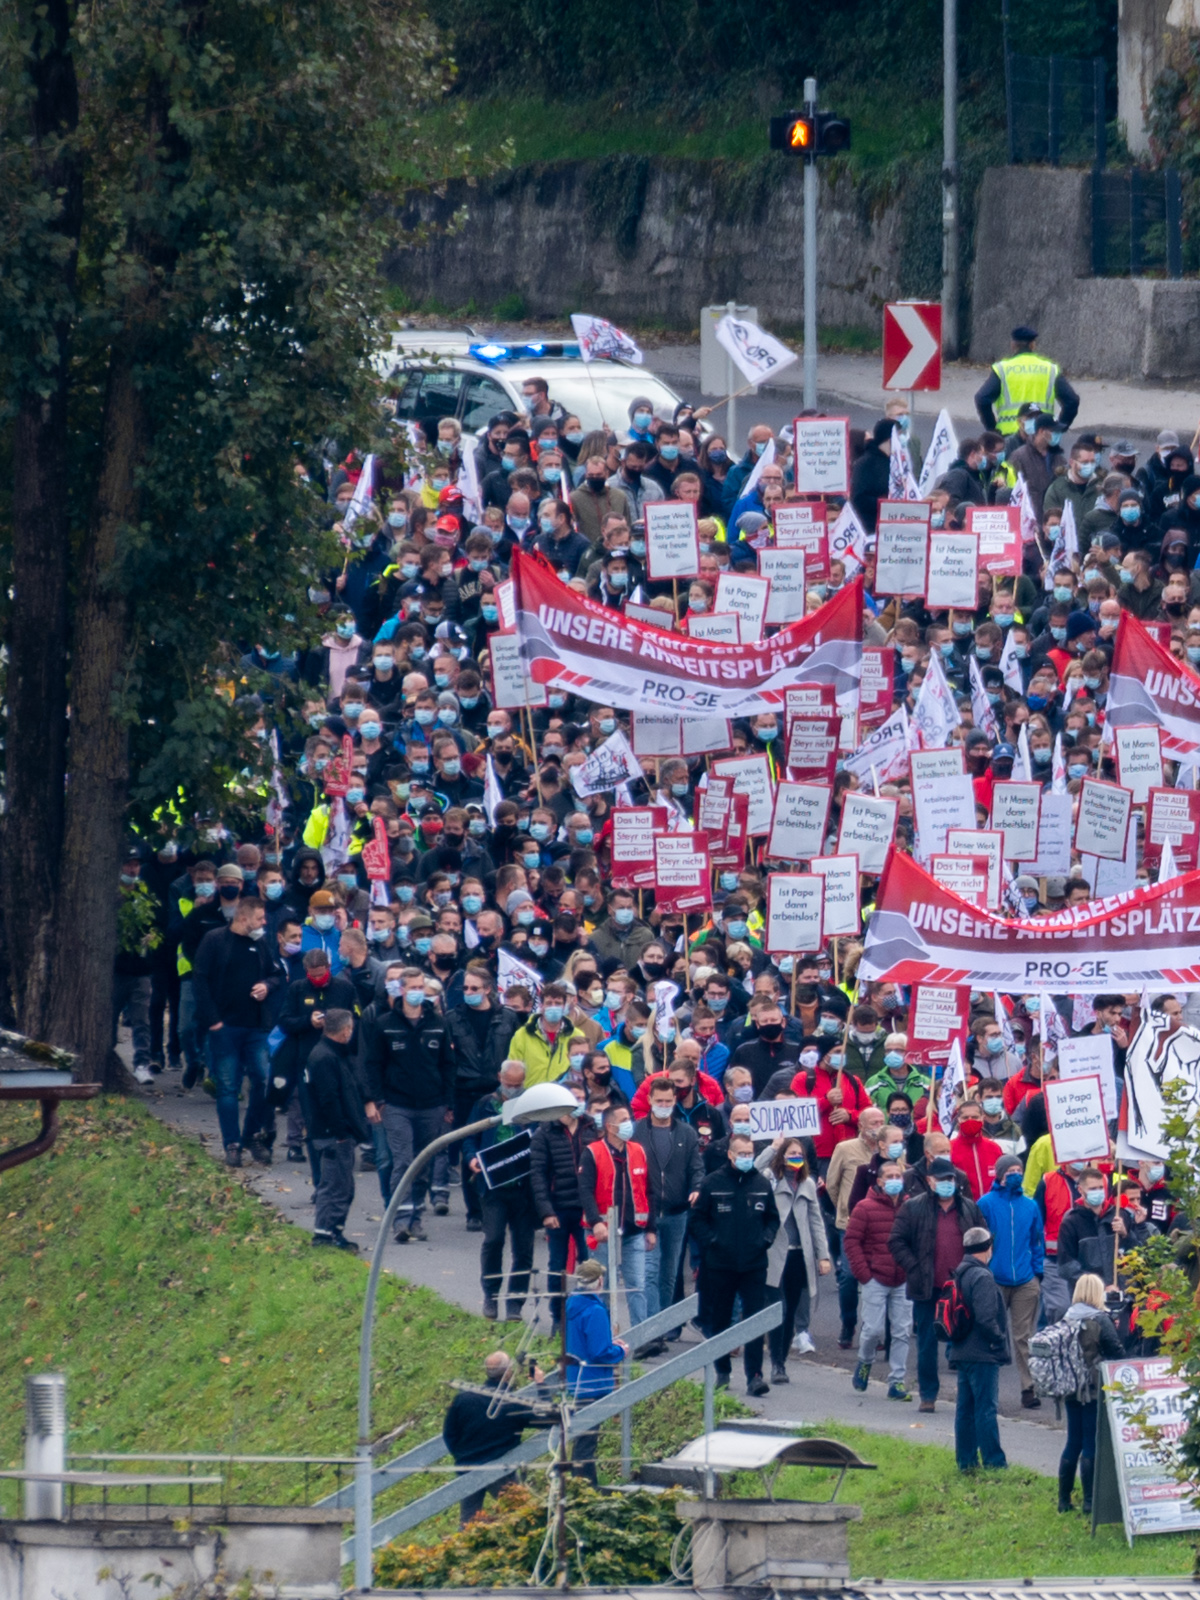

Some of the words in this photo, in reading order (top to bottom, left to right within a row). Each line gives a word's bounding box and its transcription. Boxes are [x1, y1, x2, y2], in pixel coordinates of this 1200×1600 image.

[1006, 364, 1048, 374] POLIZEI
[778, 512, 796, 520] Das
[798, 511, 810, 520] hat
[779, 526, 800, 537] Steyr
[802, 526, 822, 534] nicht
[884, 534, 893, 542] Ist
[896, 534, 922, 542] Mama
[936, 546, 944, 554] Ist
[947, 546, 972, 554] Mama
[765, 562, 774, 570] Ist
[776, 562, 799, 570] Mama
[880, 557, 923, 565] arbeitslos?
[943, 558, 964, 566] dann
[773, 572, 792, 580] dann
[932, 568, 973, 577] arbeitslos?
[725, 587, 734, 596] Ist
[736, 588, 758, 599] Papa
[728, 600, 750, 609] dann
[539, 604, 634, 653] UNSERE
[694, 628, 705, 638] Ist
[707, 627, 732, 636] Mama
[788, 693, 802, 701] Das
[804, 692, 818, 701] hat
[795, 724, 809, 732] Das
[812, 723, 825, 732] hat
[793, 739, 812, 749] Steyr
[814, 739, 834, 748] nicht
[1132, 740, 1155, 748] Mama
[791, 752, 824, 762] verdient!
[1130, 752, 1150, 760] dann
[916, 761, 936, 770] Unser
[938, 760, 958, 768] Werk
[1122, 762, 1160, 774] arbeitslos?
[743, 767, 762, 776] Werk
[786, 795, 796, 804] Ist
[798, 796, 820, 807] Papa
[999, 796, 1008, 804] Ist
[1010, 796, 1034, 804] Mama
[790, 808, 812, 817] dann
[852, 806, 863, 816] Ist
[864, 808, 886, 819] Papa
[1006, 808, 1026, 816] dann
[616, 816, 632, 824] Das
[635, 816, 650, 824] hat
[856, 820, 879, 830] dann
[994, 820, 1034, 830] arbeitslos?
[776, 820, 822, 831] arbeitslos?
[617, 832, 638, 842] Steyr
[843, 830, 889, 843] arbeitslos?
[658, 842, 674, 850] Das
[676, 840, 690, 850] hat
[953, 841, 974, 849] Unser
[976, 841, 996, 849] Werk
[660, 857, 680, 867] Steyr
[682, 856, 703, 866] nicht
[936, 862, 952, 870] Das
[956, 862, 970, 871] hat
[660, 872, 697, 882] verdient!
[827, 870, 850, 879] Mama
[961, 878, 982, 887] nicht
[779, 888, 790, 896] Ist
[792, 888, 814, 899] Papa
[785, 900, 808, 909] dann
[772, 911, 819, 922] arbeitslos?
[920, 990, 934, 998] WIR
[937, 991, 952, 999] ALLE
[936, 1004, 954, 1012] MAN
[934, 1016, 959, 1026] bleiben
[1057, 1096, 1067, 1104] Ist
[1069, 1093, 1092, 1104] Papa
[1066, 1106, 1088, 1116] dann
[750, 1102, 818, 1134] SOLIDARITÄT
[1054, 1115, 1100, 1130] arbeitslos?
